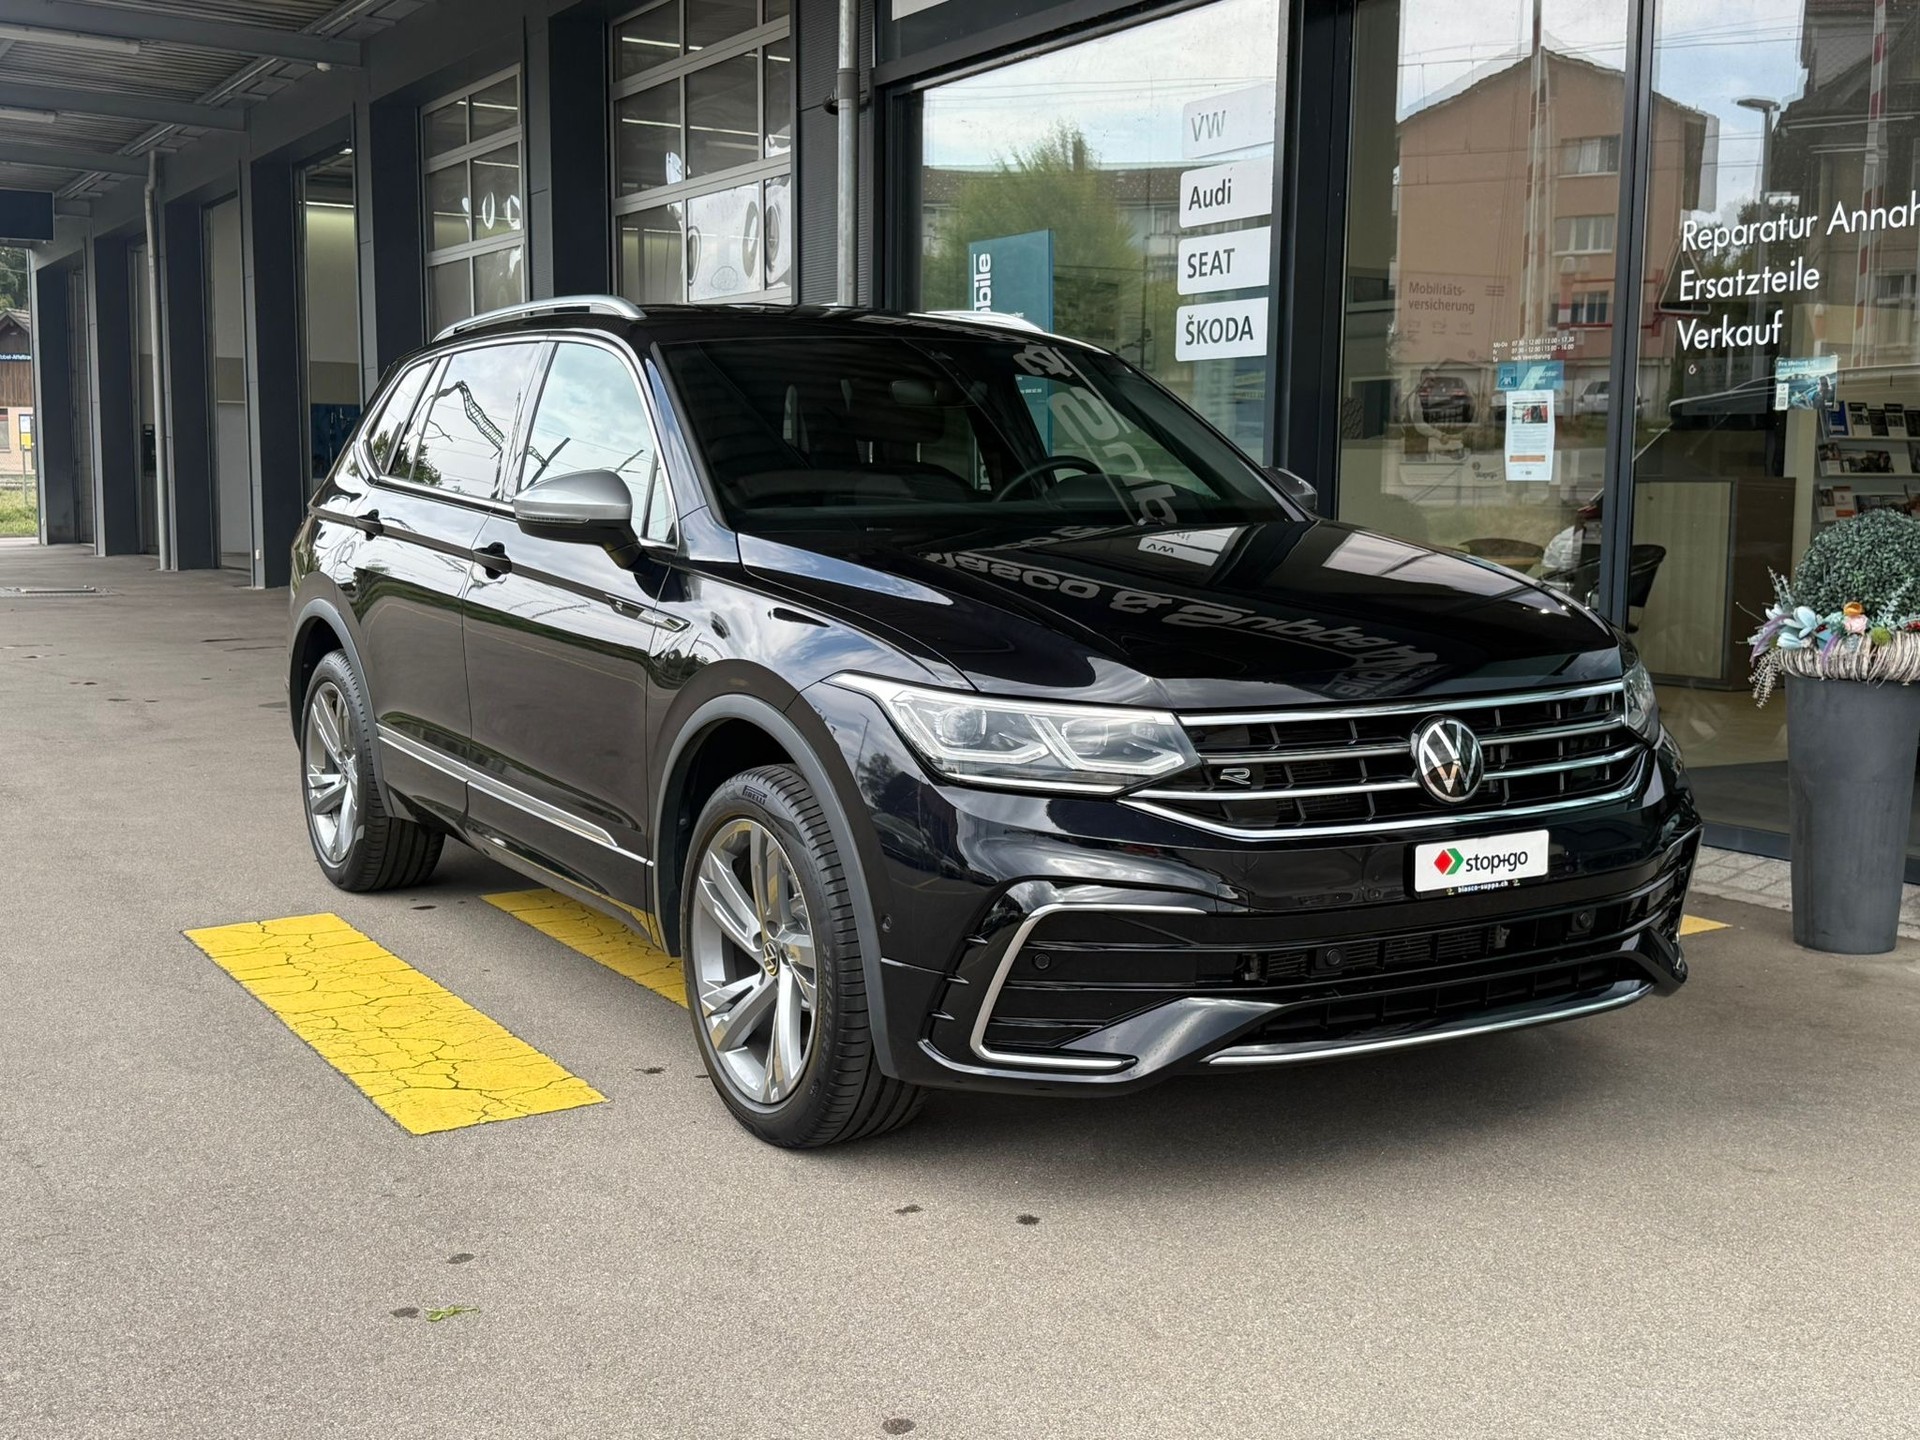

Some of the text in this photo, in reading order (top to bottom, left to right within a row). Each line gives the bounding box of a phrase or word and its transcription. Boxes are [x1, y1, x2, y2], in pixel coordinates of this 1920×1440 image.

[1191, 110, 1226, 142] VW
[1188, 178, 1232, 211] Audi
[1682, 213, 1818, 257] Reparatur
[1187, 248, 1235, 279] SEAT
[1679, 256, 1820, 301] Ersatzteile
[1409, 282, 1466, 296] Mobilitäts-
[1408, 299, 1475, 315] versicherung
[1185, 315, 1254, 345] ŠKODA
[1677, 310, 1783, 351] Verkauf
[1220, 767, 1251, 785] R
[742, 785, 768, 805] PIRELLI
[1465, 851, 1528, 875] stop+go
[1457, 880, 1509, 894] biasco-suppa.ch
